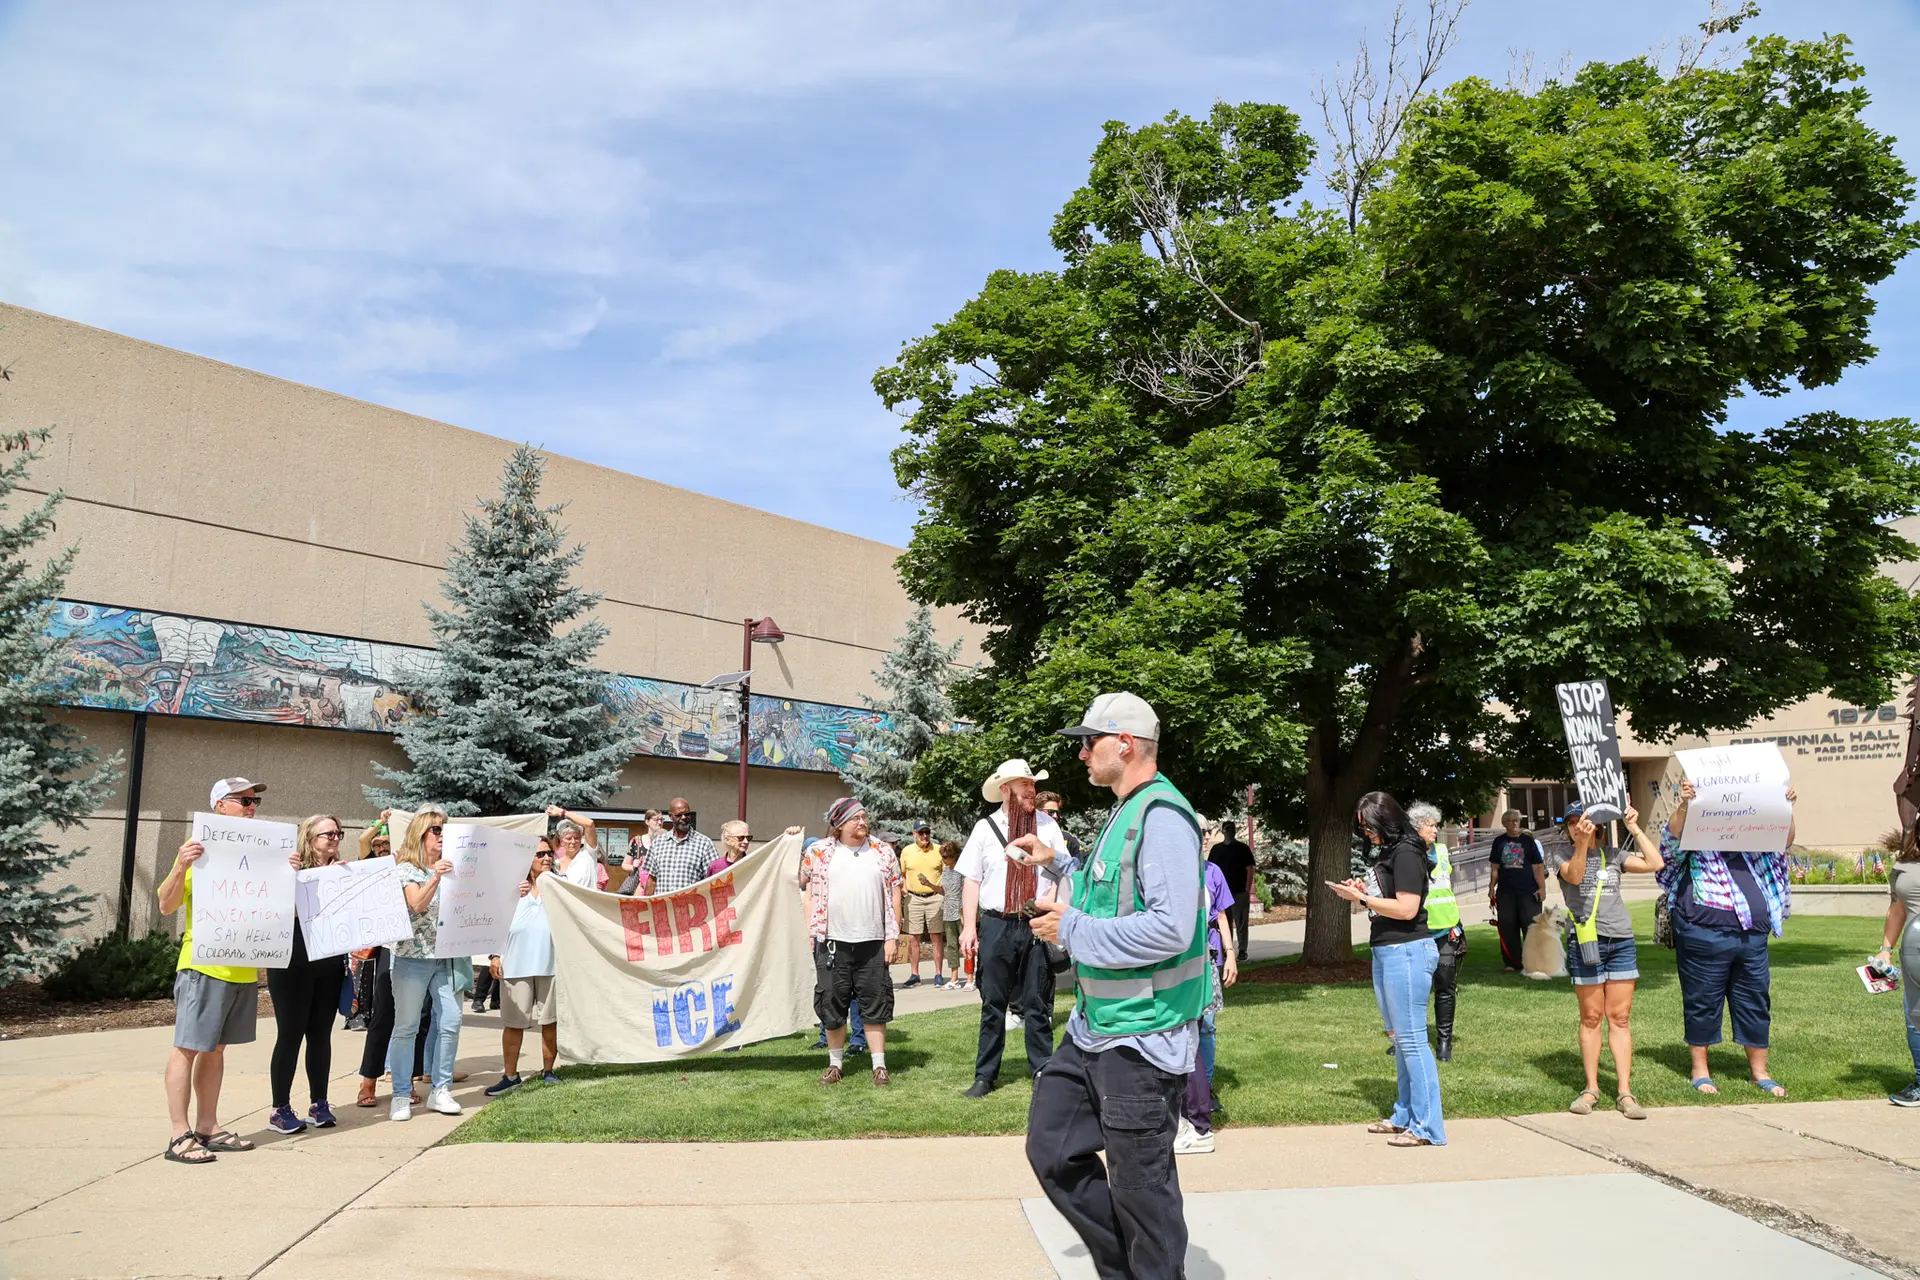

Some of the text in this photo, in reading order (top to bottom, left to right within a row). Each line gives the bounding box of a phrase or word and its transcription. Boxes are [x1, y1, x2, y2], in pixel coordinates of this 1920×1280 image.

[1558, 682, 1606, 716] STOP
[1850, 729, 1900, 743] HALL
[1814, 745, 1846, 754] PASO
[1850, 742, 1900, 752] COUNTY
[1571, 744, 1602, 771] IZING
[1577, 758, 1629, 809] FASCISM
[1694, 772, 1761, 788] IGNORANCE
[1721, 792, 1743, 803] NOT
[1701, 805, 1757, 820] Immigrants
[200, 824, 295, 849] DETENTION IS
[238, 855, 250, 870] A
[212, 879, 268, 899] MAGA
[196, 908, 281, 923] INVENTION
[619, 871, 743, 962] FIRE
[214, 927, 290, 943] SAY HELL NO
[197, 943, 289, 960] COLORADO SPRINGS!
[651, 974, 742, 1048] ICE
